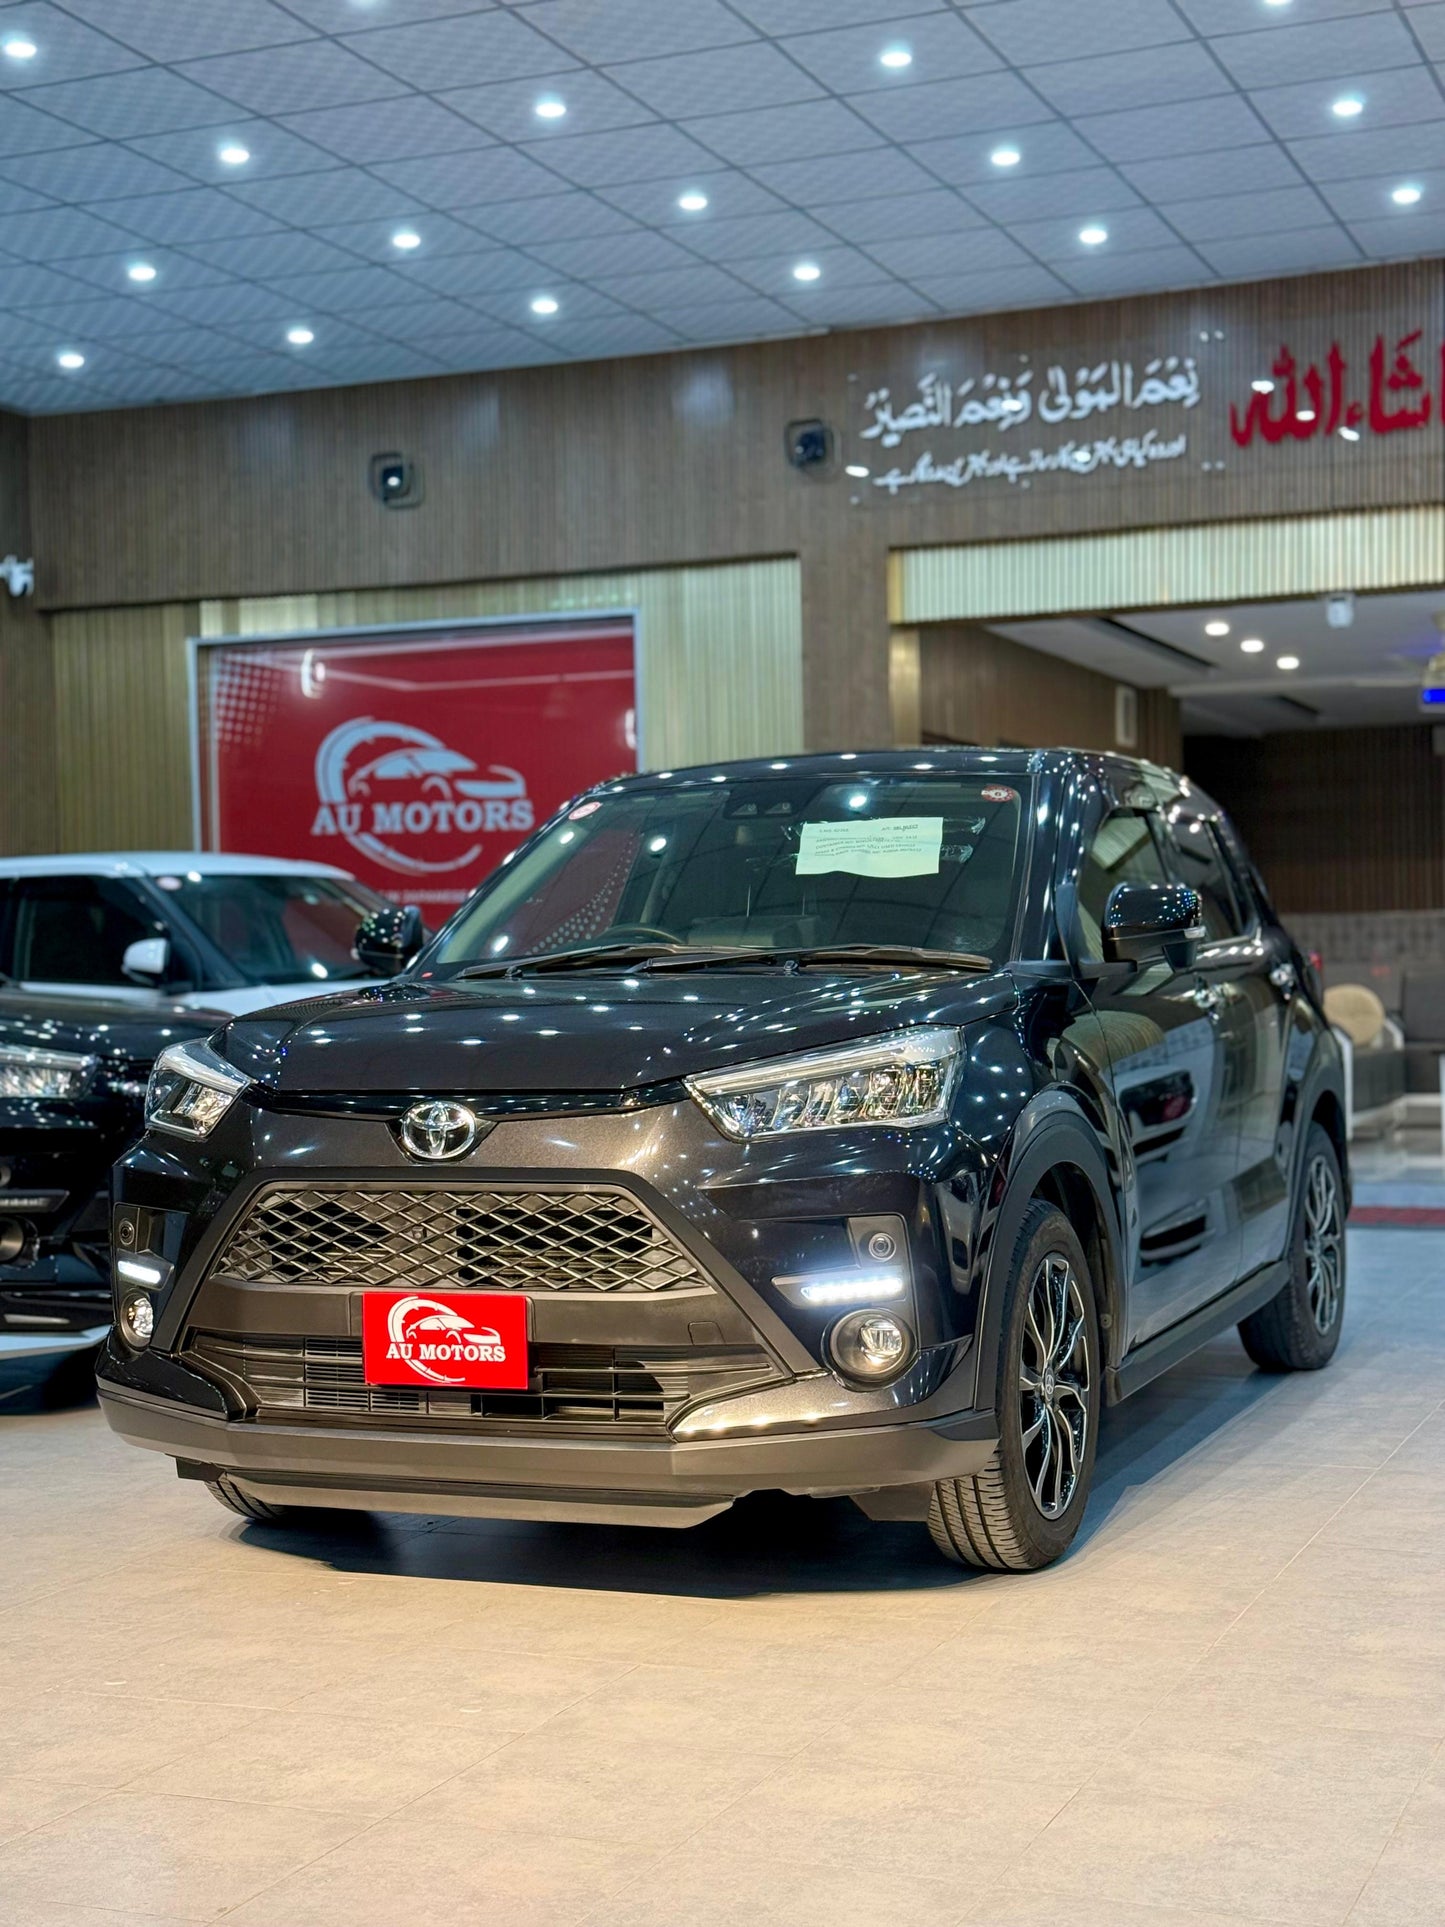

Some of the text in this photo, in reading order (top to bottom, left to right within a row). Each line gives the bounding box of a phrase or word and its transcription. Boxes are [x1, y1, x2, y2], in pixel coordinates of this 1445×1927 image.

[311, 802, 361, 835] AU
[372, 798, 535, 833] MOTORS
[386, 1343, 507, 1362] AU MOTORS
